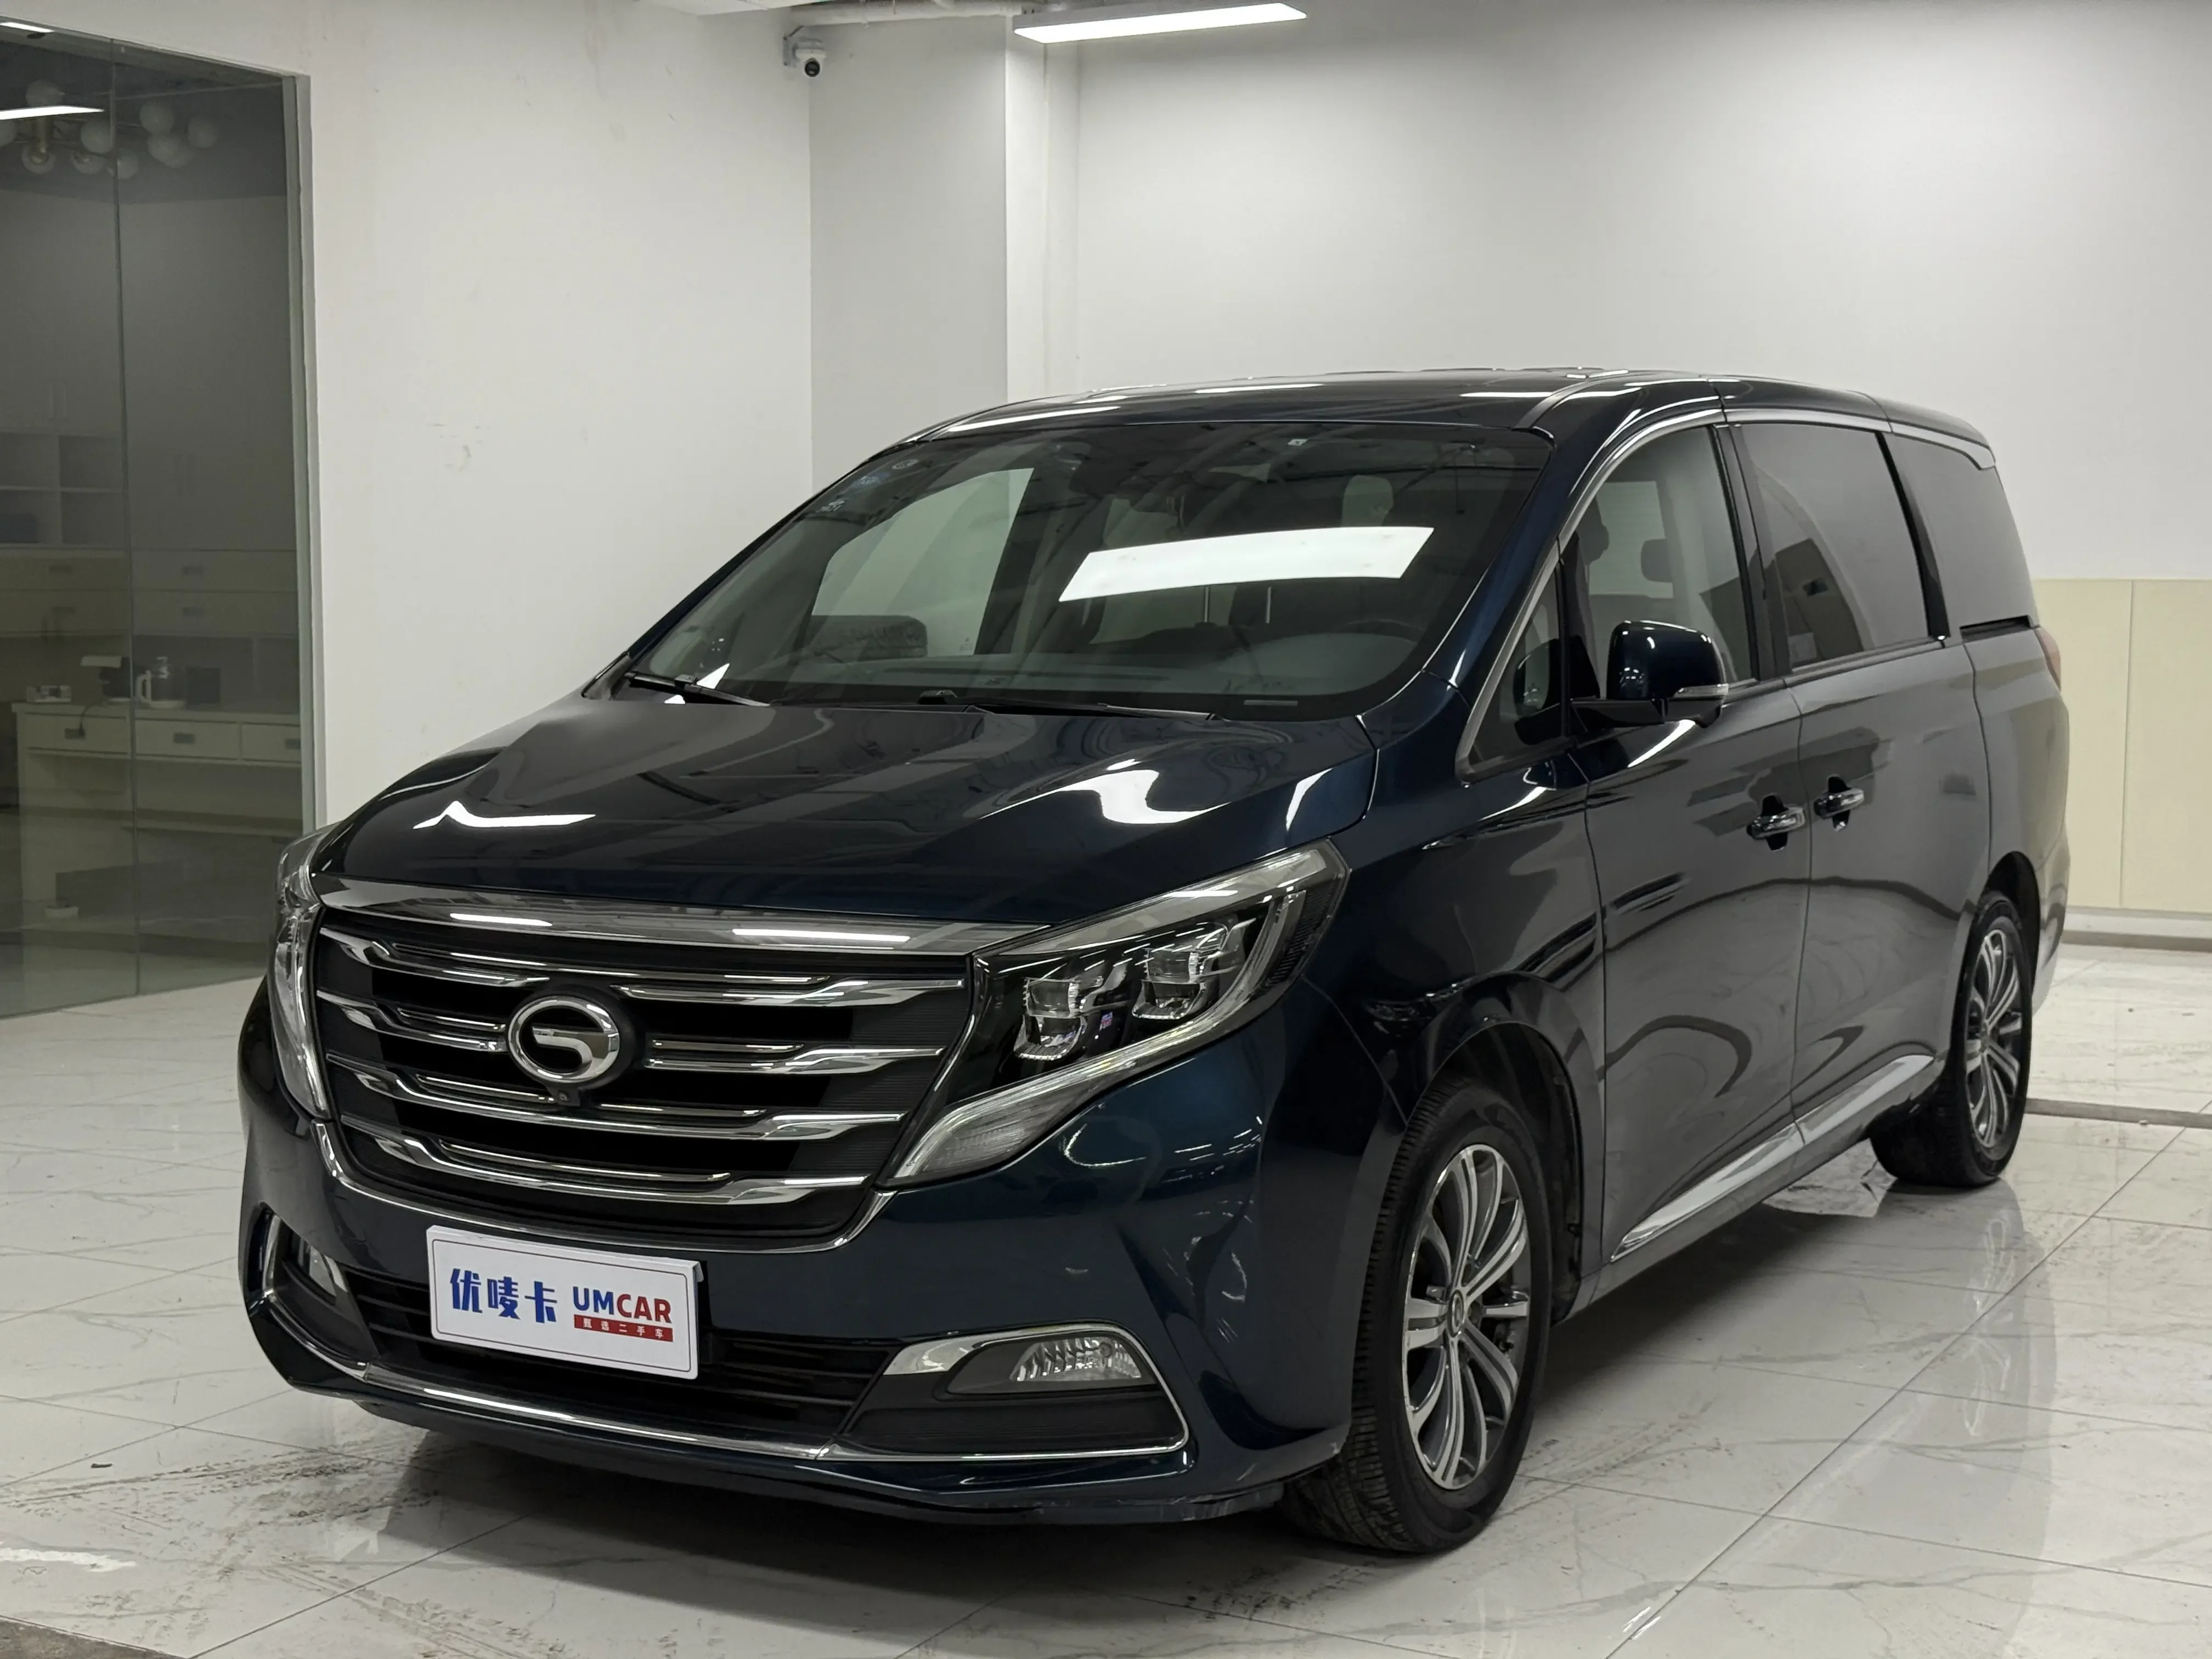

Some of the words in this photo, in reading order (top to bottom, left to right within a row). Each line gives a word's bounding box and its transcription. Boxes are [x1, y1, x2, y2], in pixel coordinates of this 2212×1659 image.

[450, 1268, 557, 1324] 优唛卡
[573, 1286, 673, 1324] UMCAR
